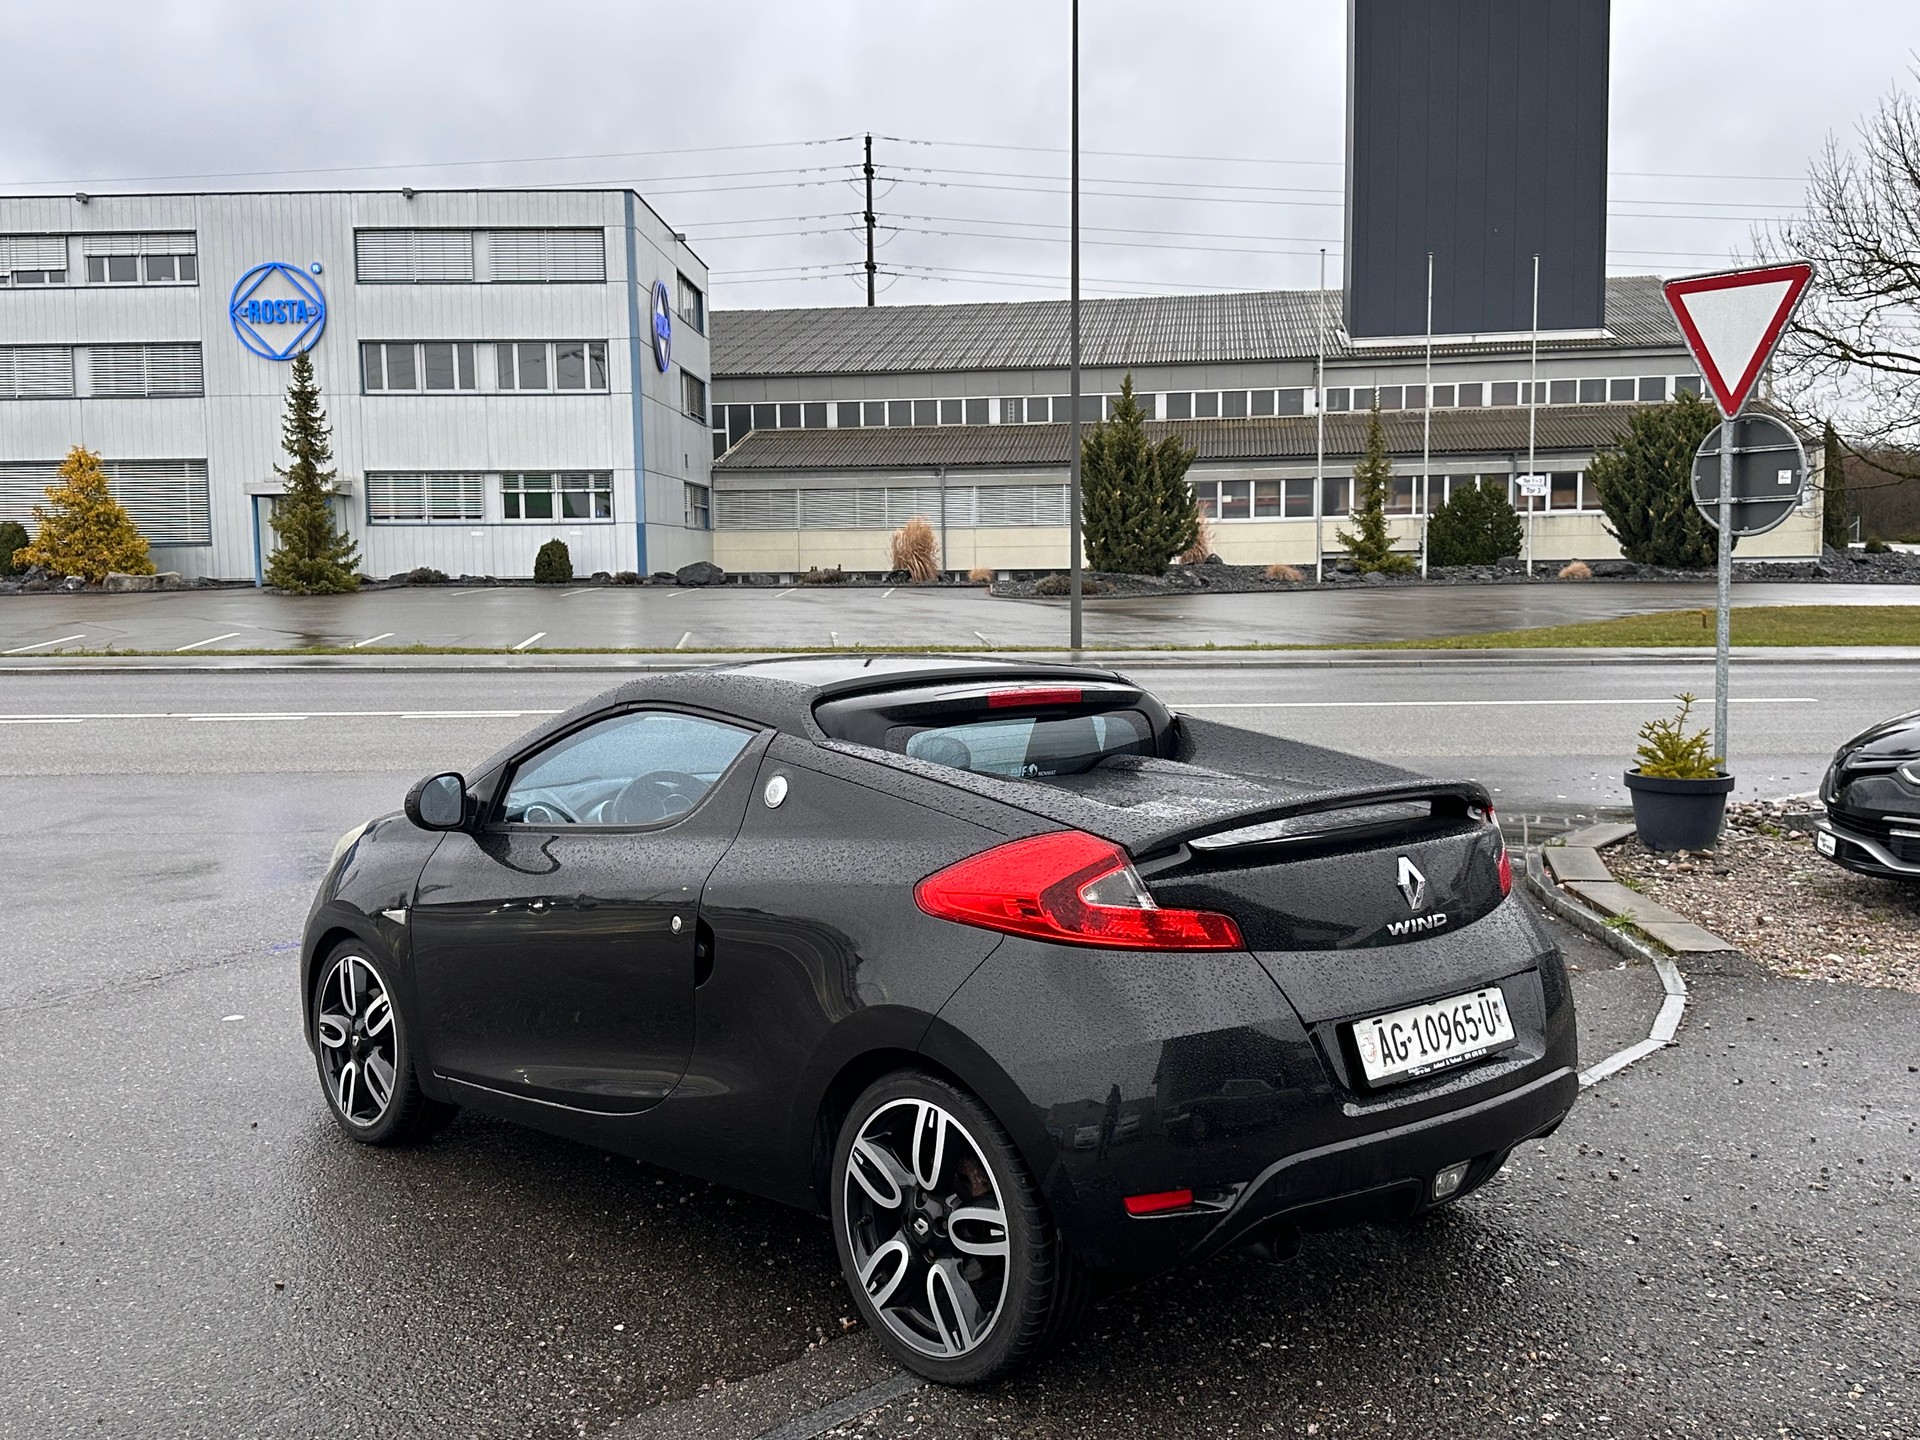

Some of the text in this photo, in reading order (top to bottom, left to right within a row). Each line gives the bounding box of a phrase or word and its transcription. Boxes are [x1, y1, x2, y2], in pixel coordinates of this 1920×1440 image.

[248, 299, 309, 324] ROSTA
[1010, 765, 1027, 776] elf
[1387, 913, 1447, 936] WIND
